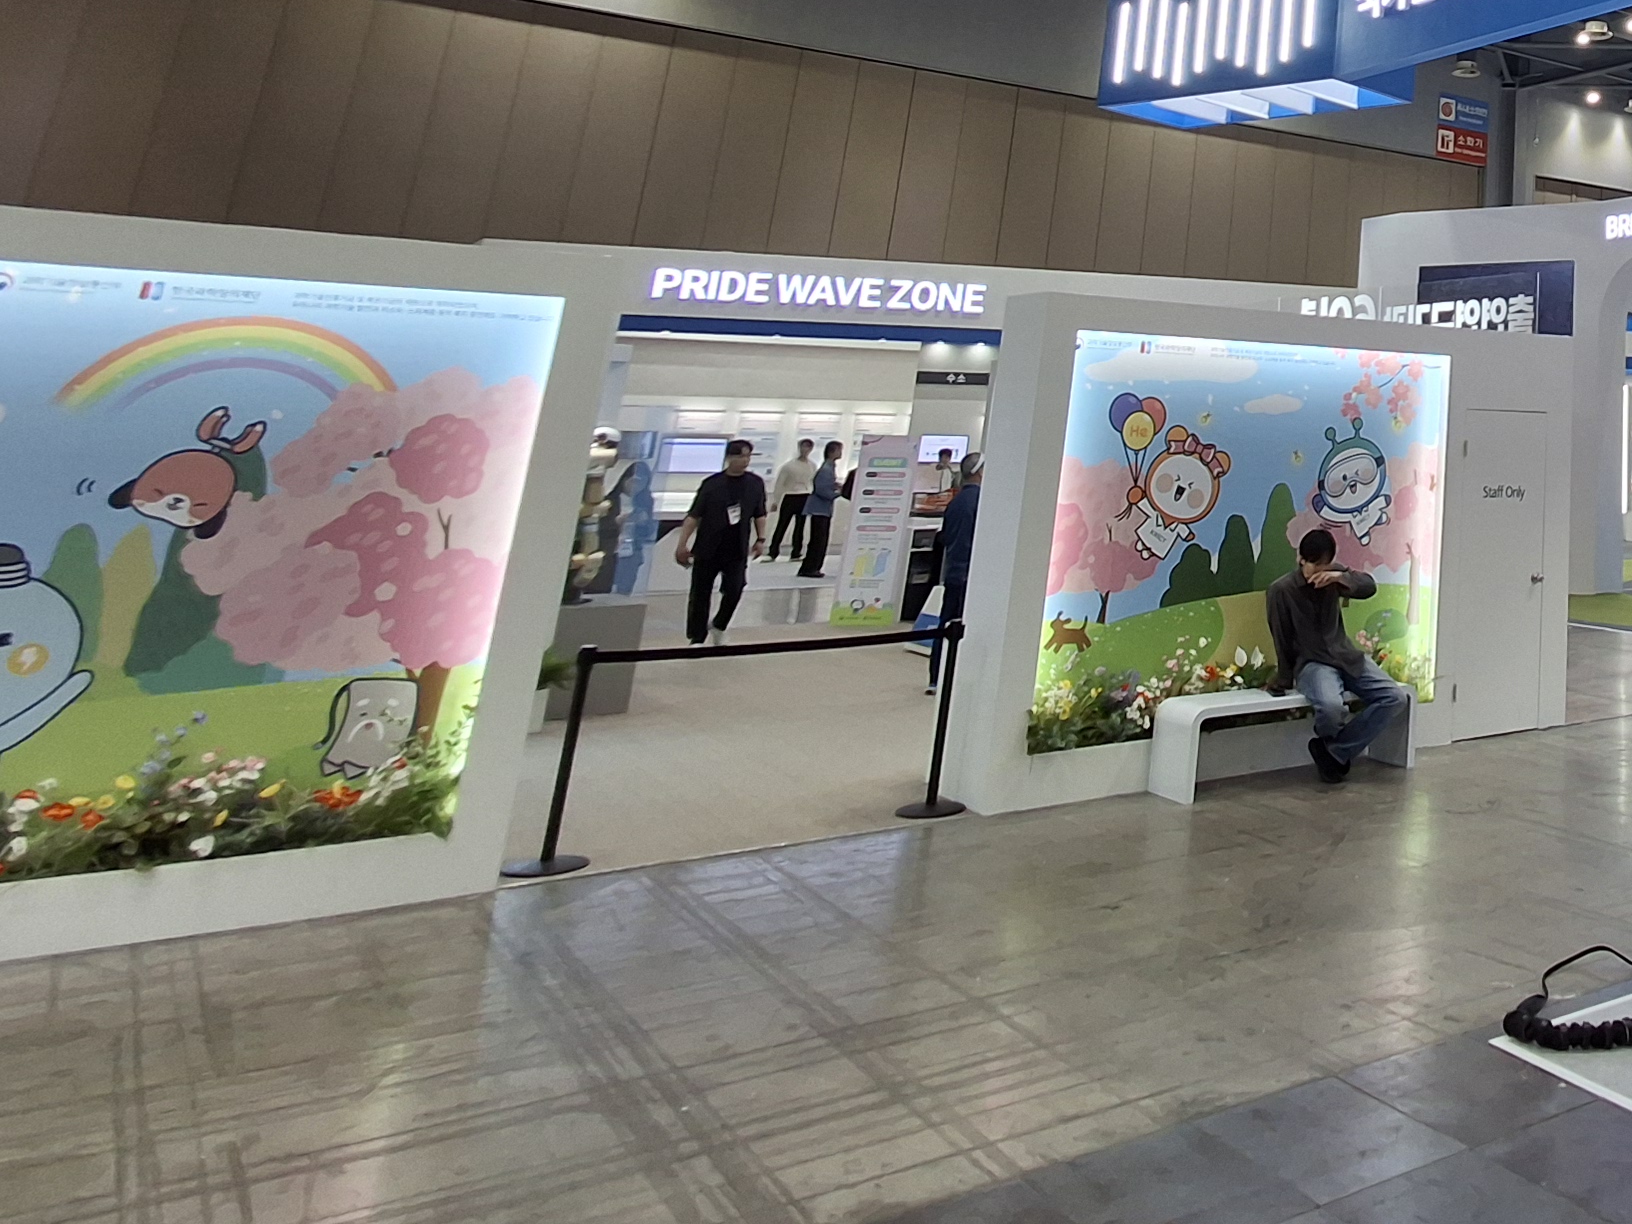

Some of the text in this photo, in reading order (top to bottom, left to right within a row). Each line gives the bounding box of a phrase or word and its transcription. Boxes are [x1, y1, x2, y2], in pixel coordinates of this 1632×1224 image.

[1458, 136, 1483, 149] 소화기
[651, 267, 987, 313] PRIDE WAVE ZONE
[946, 373, 966, 384] 수소
[1130, 425, 1148, 438] He
[1483, 485, 1526, 502] Staff Only
